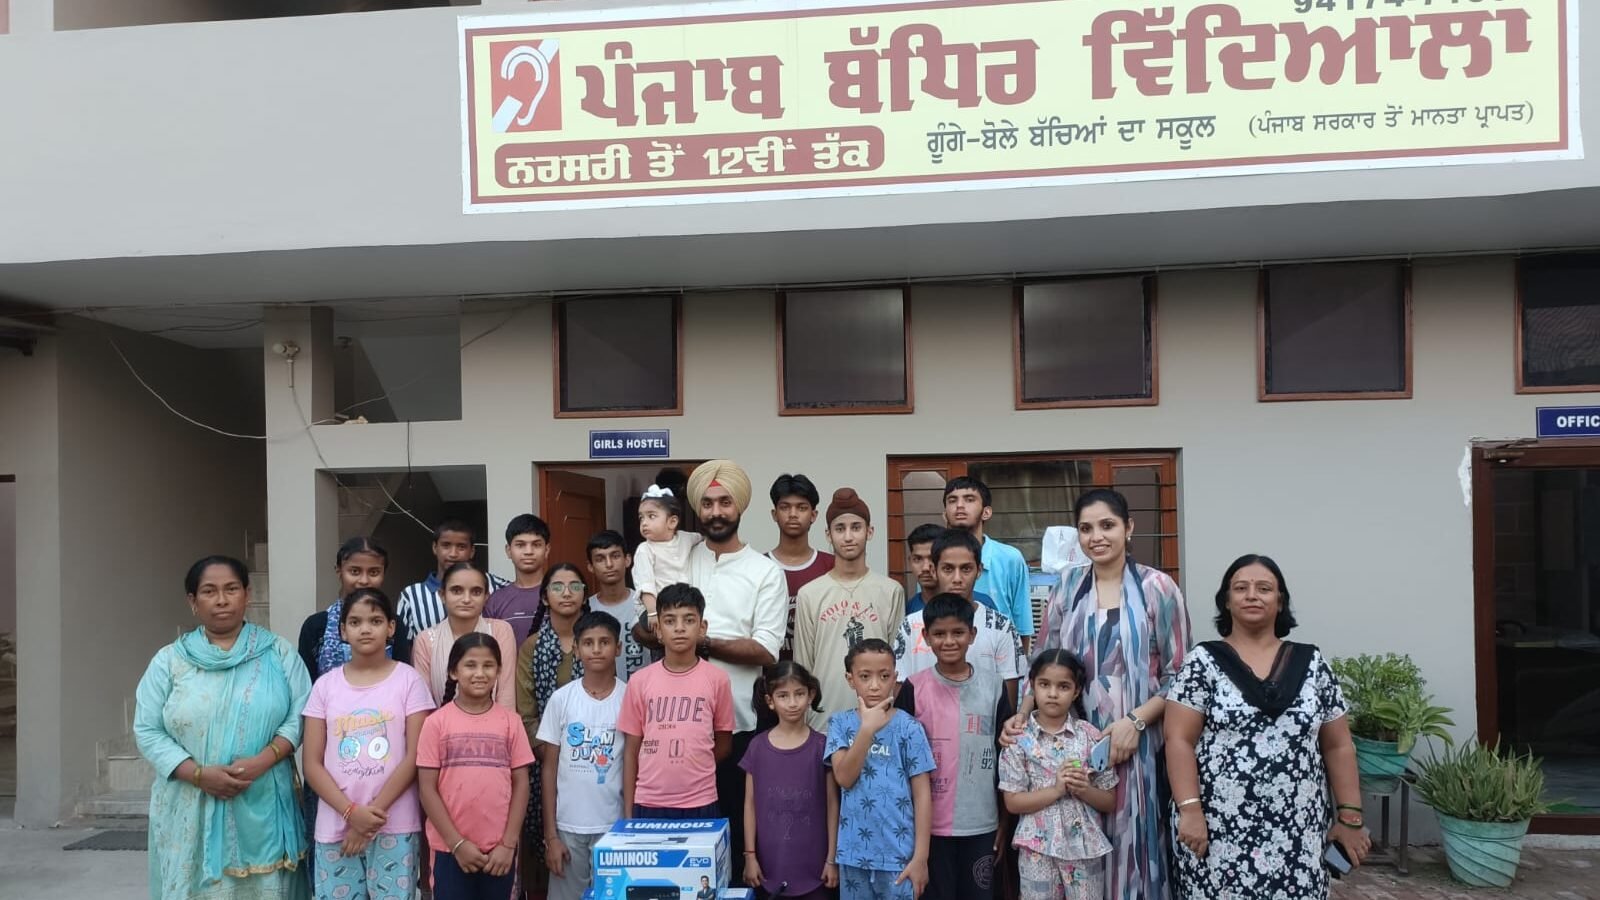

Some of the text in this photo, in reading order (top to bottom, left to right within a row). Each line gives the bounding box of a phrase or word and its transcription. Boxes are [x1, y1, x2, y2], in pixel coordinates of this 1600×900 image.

[576, 41, 785, 127] ਪੰਜਾਬ
[1082, 4, 1532, 100] ਵਿੱਦਿਆਲਾ
[1249, 100, 1534, 138] (ਪੰਜਾਬ ਸਰਕਾਰ ਤੋਂ ਮਾਨਤਾ ਪ੍ਰਾਪਤ)
[927, 115, 1217, 164] ਗੂੰਗੇ-ਬੋਲੇ ਬੱਚਿਆਂ ਦਾ ਸਕੂਲ
[505, 132, 872, 185] ਨਰਸਰੀ ਤੋਂ 12ਵੀਂ ਤੱਕ
[1556, 415, 1600, 428] OFFIC
[593, 438, 666, 450] GIRLS HOSTEL
[625, 821, 714, 830] LUMINOUS
[599, 851, 659, 866] LUMINOUS
